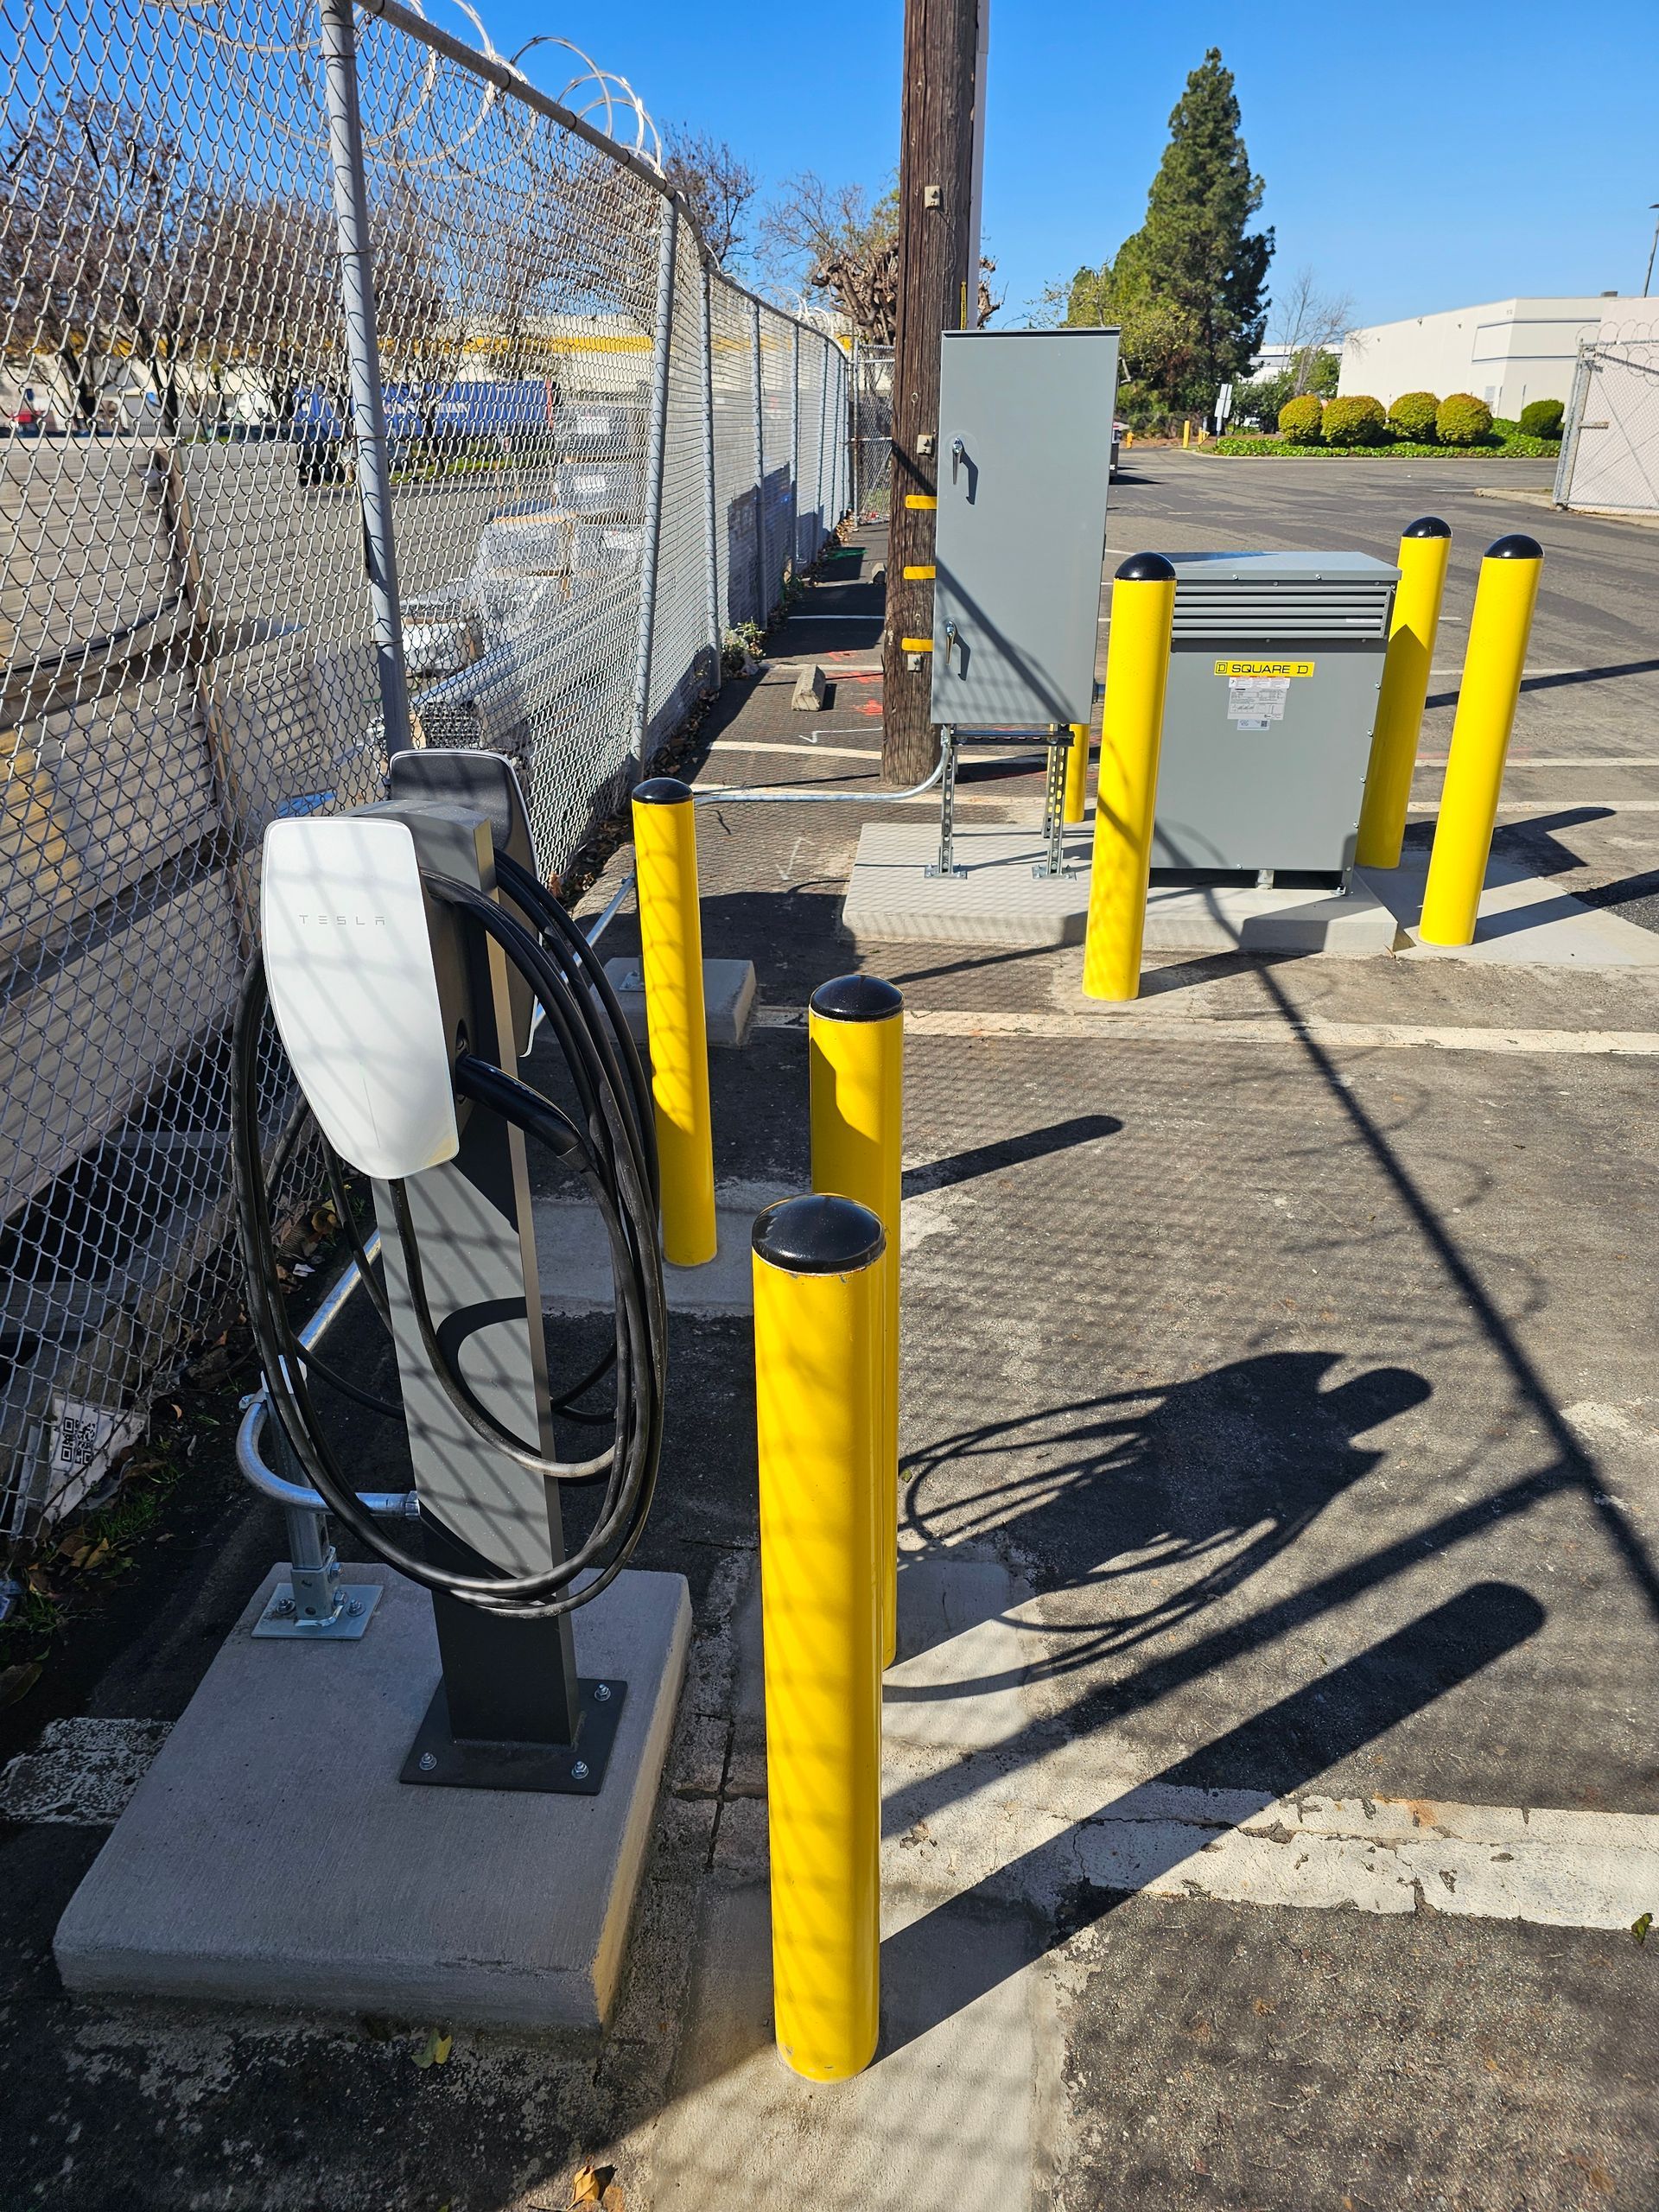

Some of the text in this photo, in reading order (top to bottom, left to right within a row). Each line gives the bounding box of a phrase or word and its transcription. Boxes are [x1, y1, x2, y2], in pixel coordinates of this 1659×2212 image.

[1217, 663, 1309, 674] D SQUARE D
[299, 914, 386, 926] TESLA
